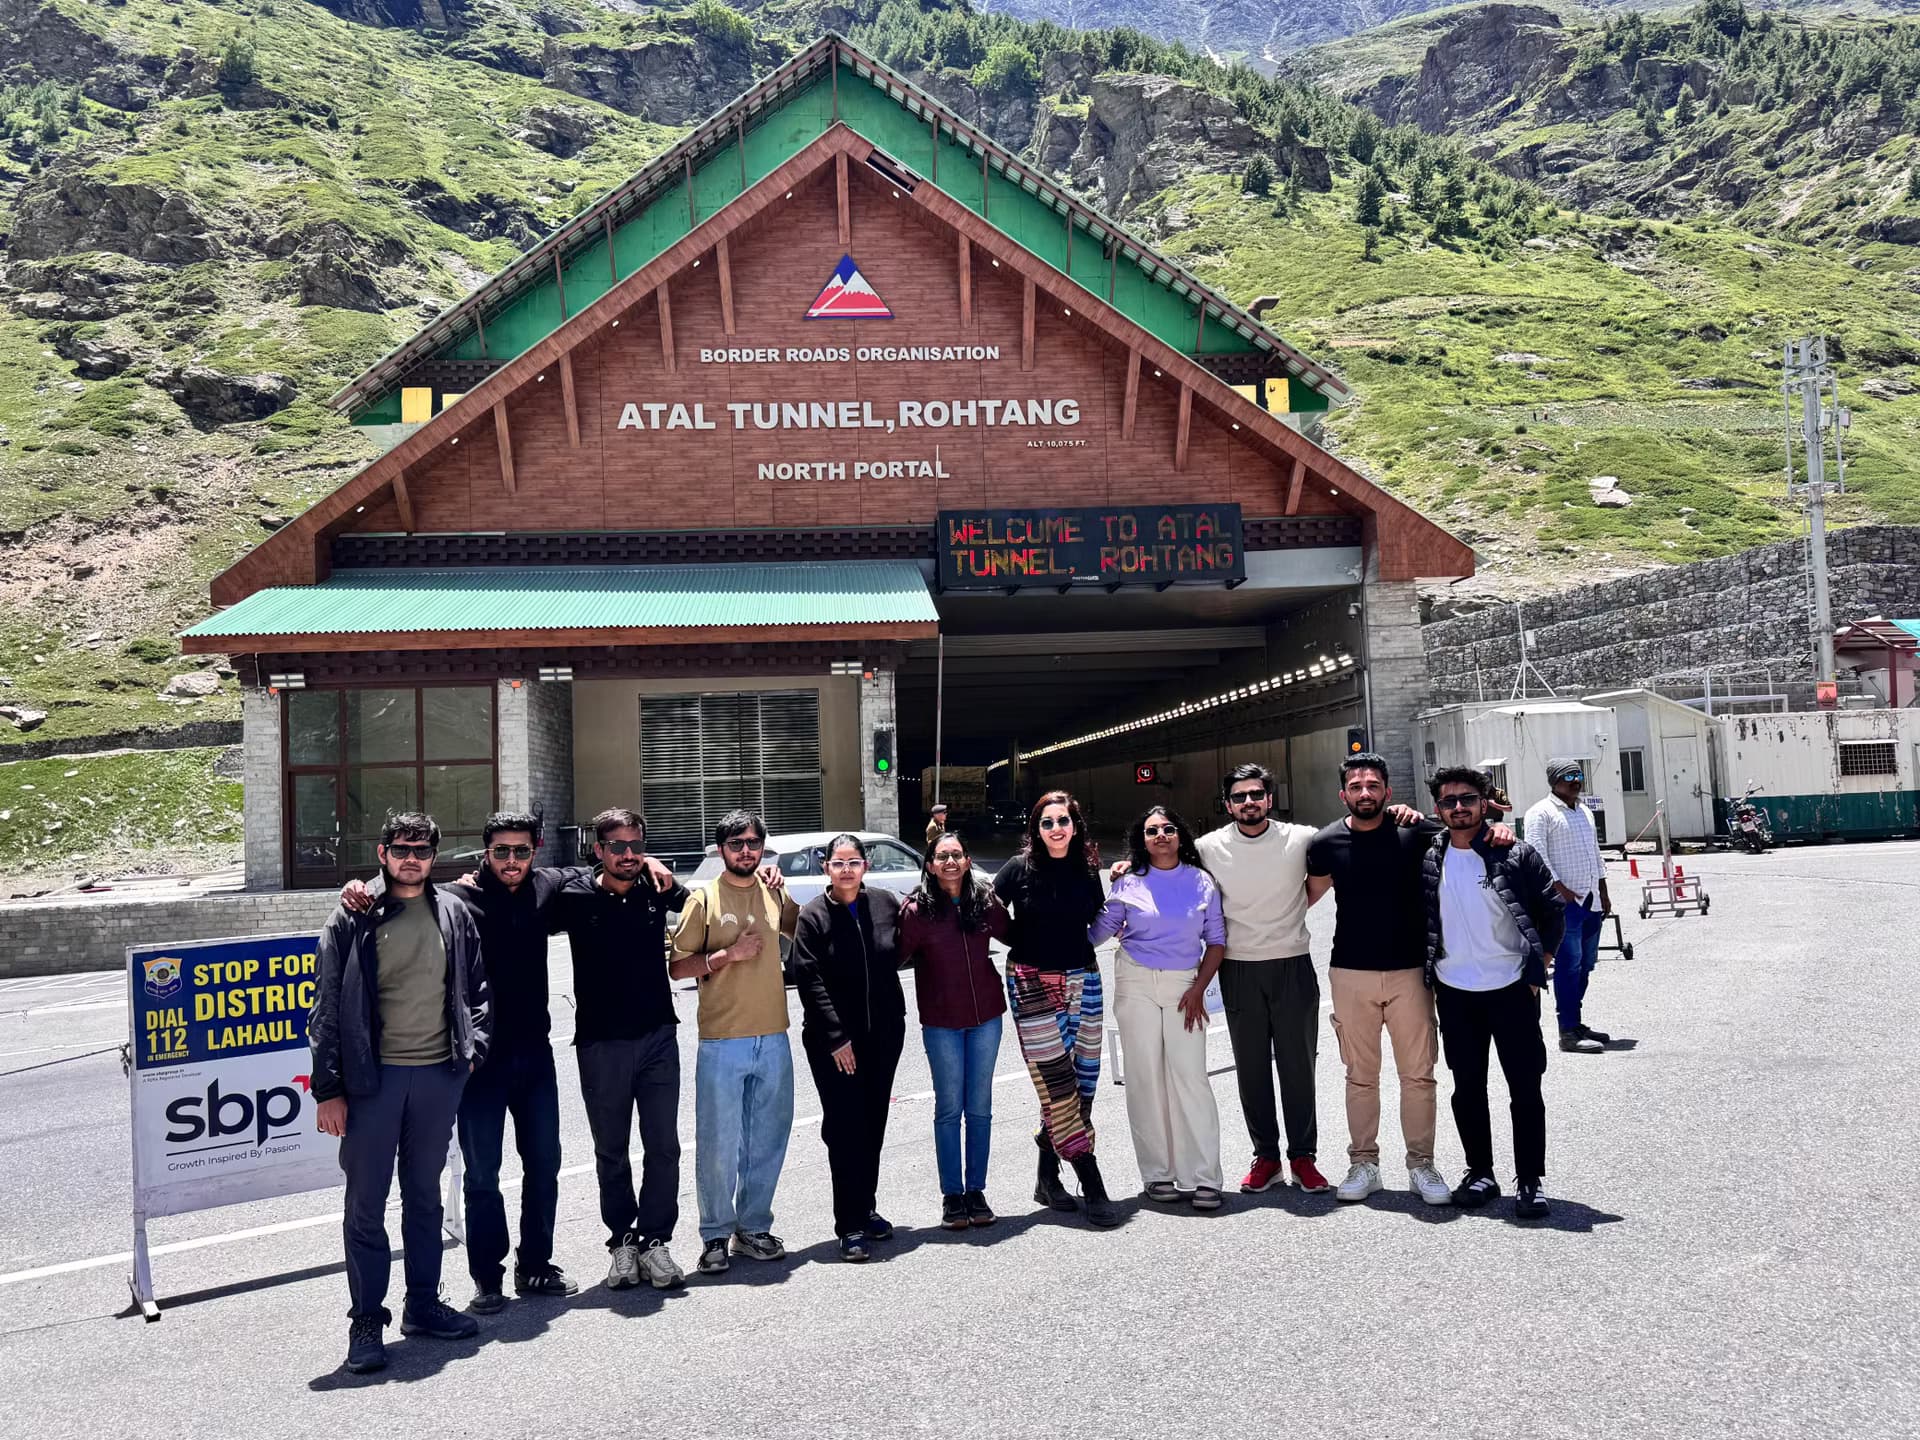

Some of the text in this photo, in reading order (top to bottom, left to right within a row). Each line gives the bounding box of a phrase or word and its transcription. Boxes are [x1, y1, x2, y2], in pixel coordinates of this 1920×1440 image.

[701, 345, 1000, 363] BORDER ROADS ORGANISATION
[617, 402, 716, 430] ATAL
[1046, 440, 1074, 448] 10,075
[758, 460, 950, 480] NORTH PORTAL
[1100, 514, 1137, 541] TO
[1157, 512, 1232, 540] ATAL
[1100, 543, 1234, 573] ROHTANG
[1141, 769, 1150, 777] 40
[194, 953, 316, 986] STOP FOR
[195, 981, 315, 1022] DISTRIC
[146, 1008, 188, 1030] DIAL
[147, 1028, 188, 1053] 112
[207, 1020, 298, 1050] LAHAUL
[155, 1050, 190, 1061] EMERGENCY
[165, 1077, 302, 1148] sbp
[167, 1142, 301, 1172] Growth Inspired By Passion
